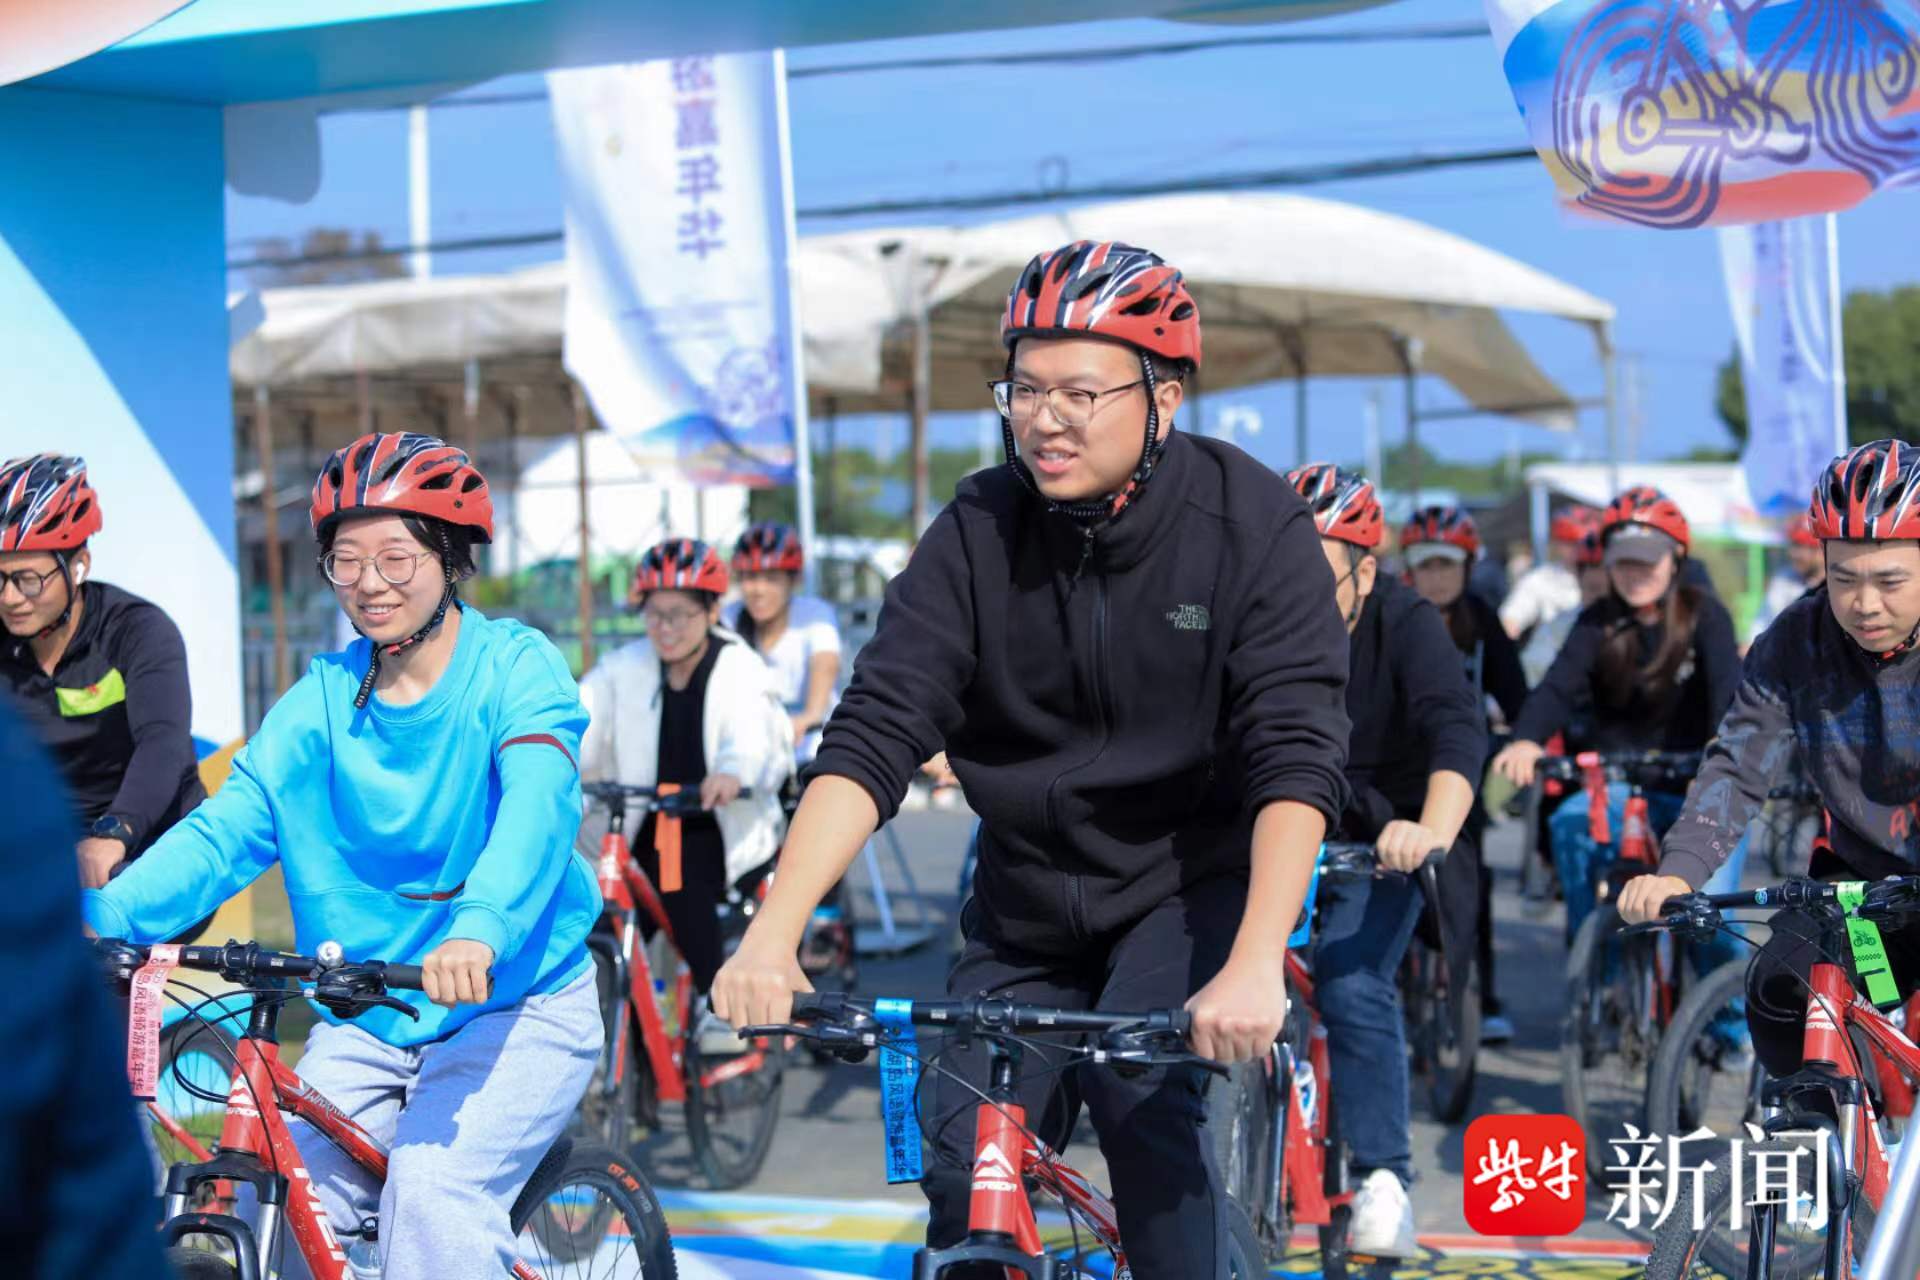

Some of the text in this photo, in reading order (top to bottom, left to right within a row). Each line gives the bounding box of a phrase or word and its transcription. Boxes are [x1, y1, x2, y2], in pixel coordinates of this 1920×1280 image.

[1178, 604, 1198, 613] THE
[1166, 611, 1199, 621] NORTH
[1174, 620, 1199, 629] FACE
